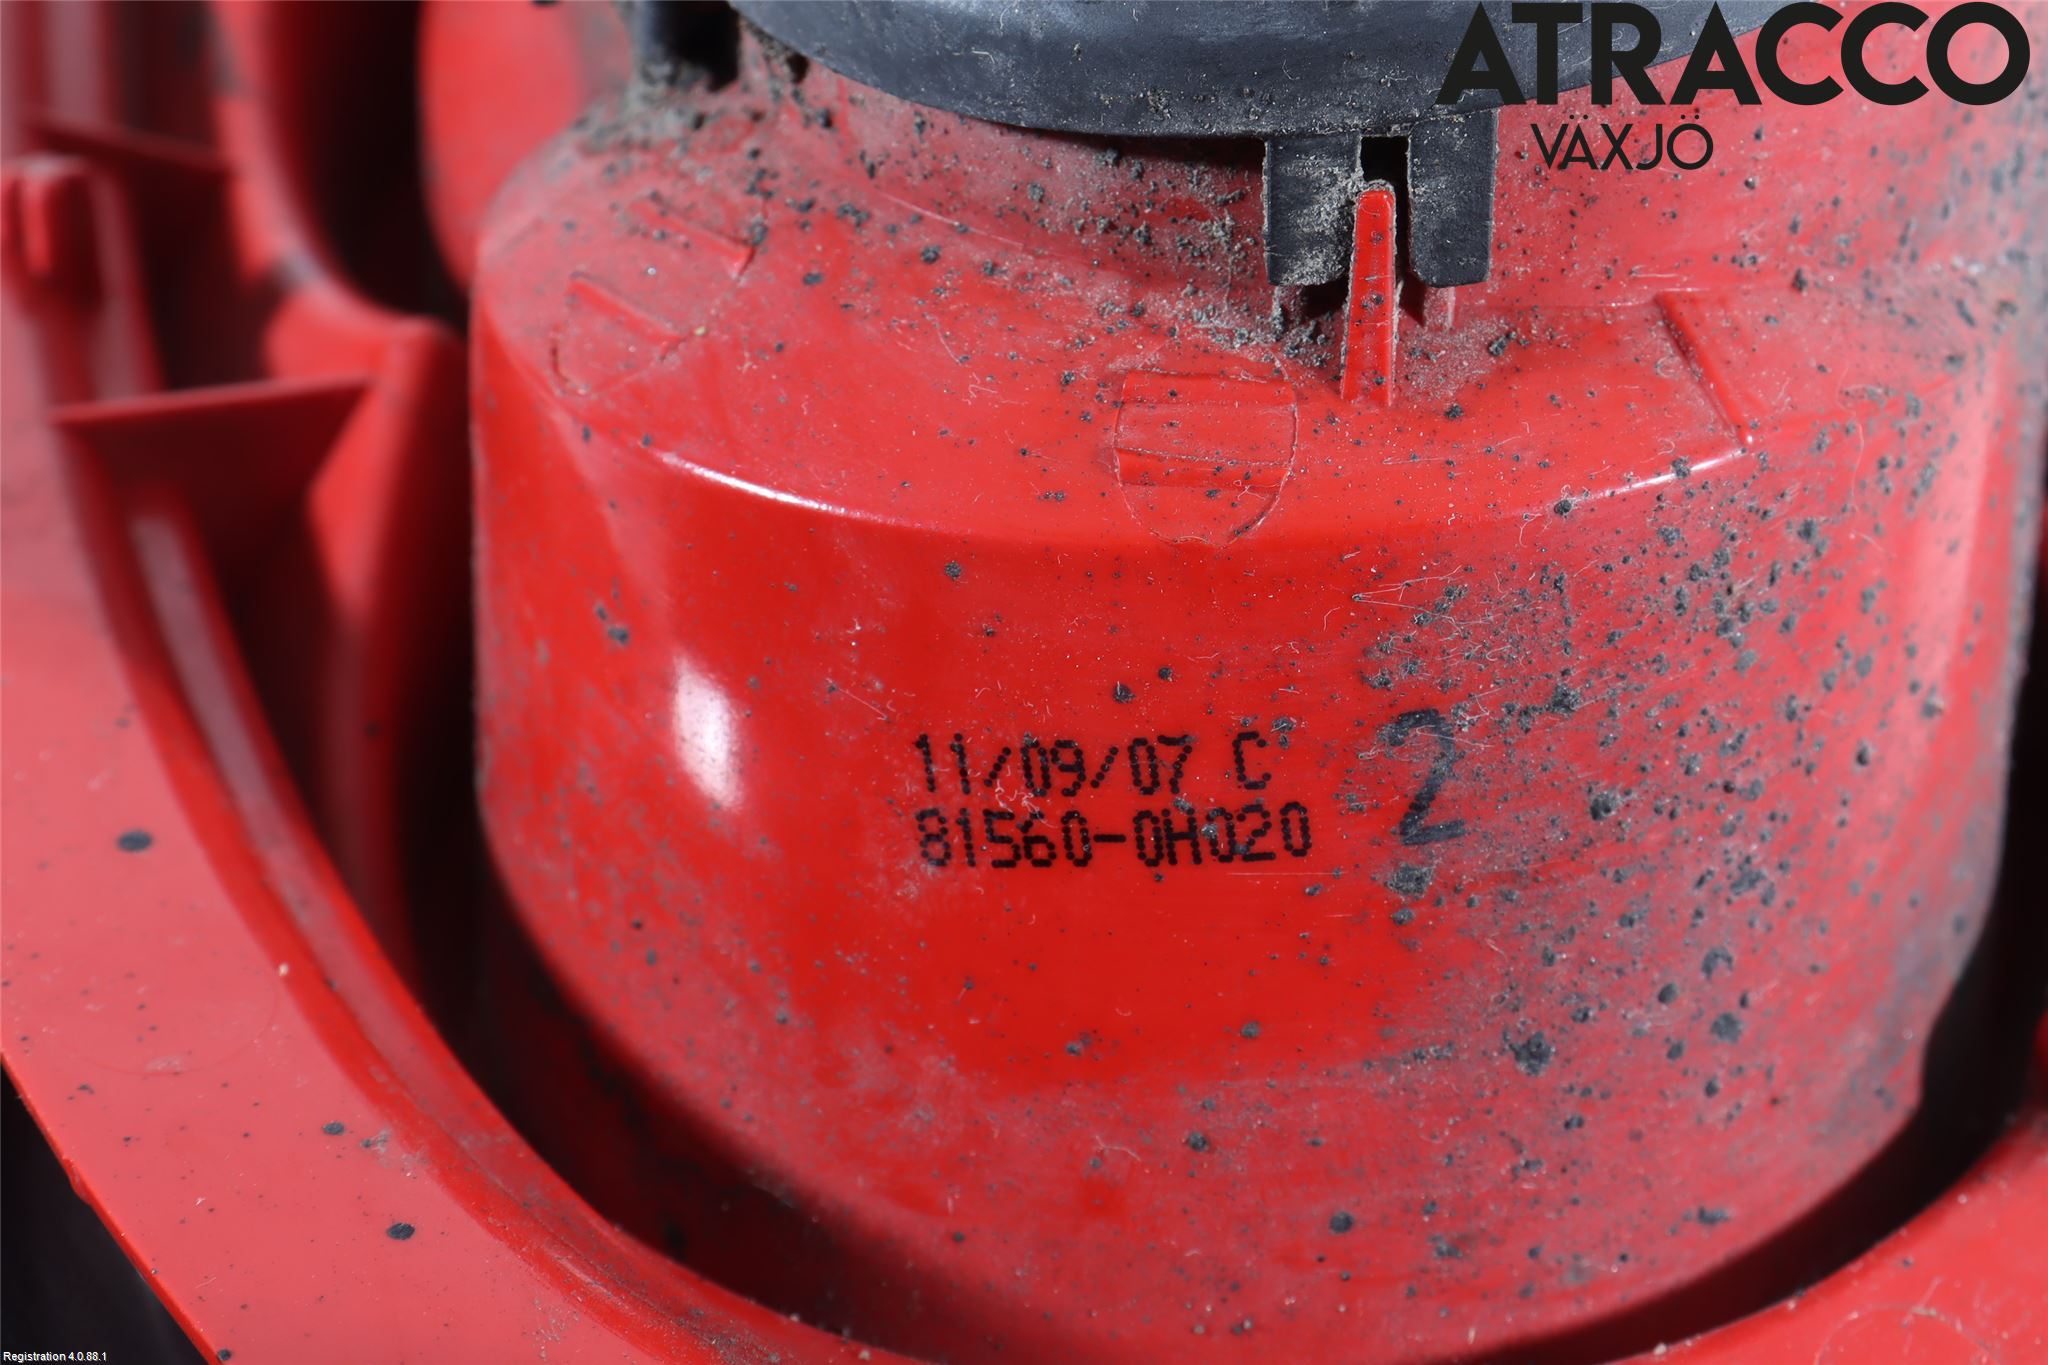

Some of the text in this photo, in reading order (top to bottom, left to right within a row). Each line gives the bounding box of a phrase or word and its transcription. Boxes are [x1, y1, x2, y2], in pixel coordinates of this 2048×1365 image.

[916, 731, 1271, 796] 11/09/07 C
[1393, 708, 1465, 845] 2
[916, 802, 1312, 868] 81560-0H020
